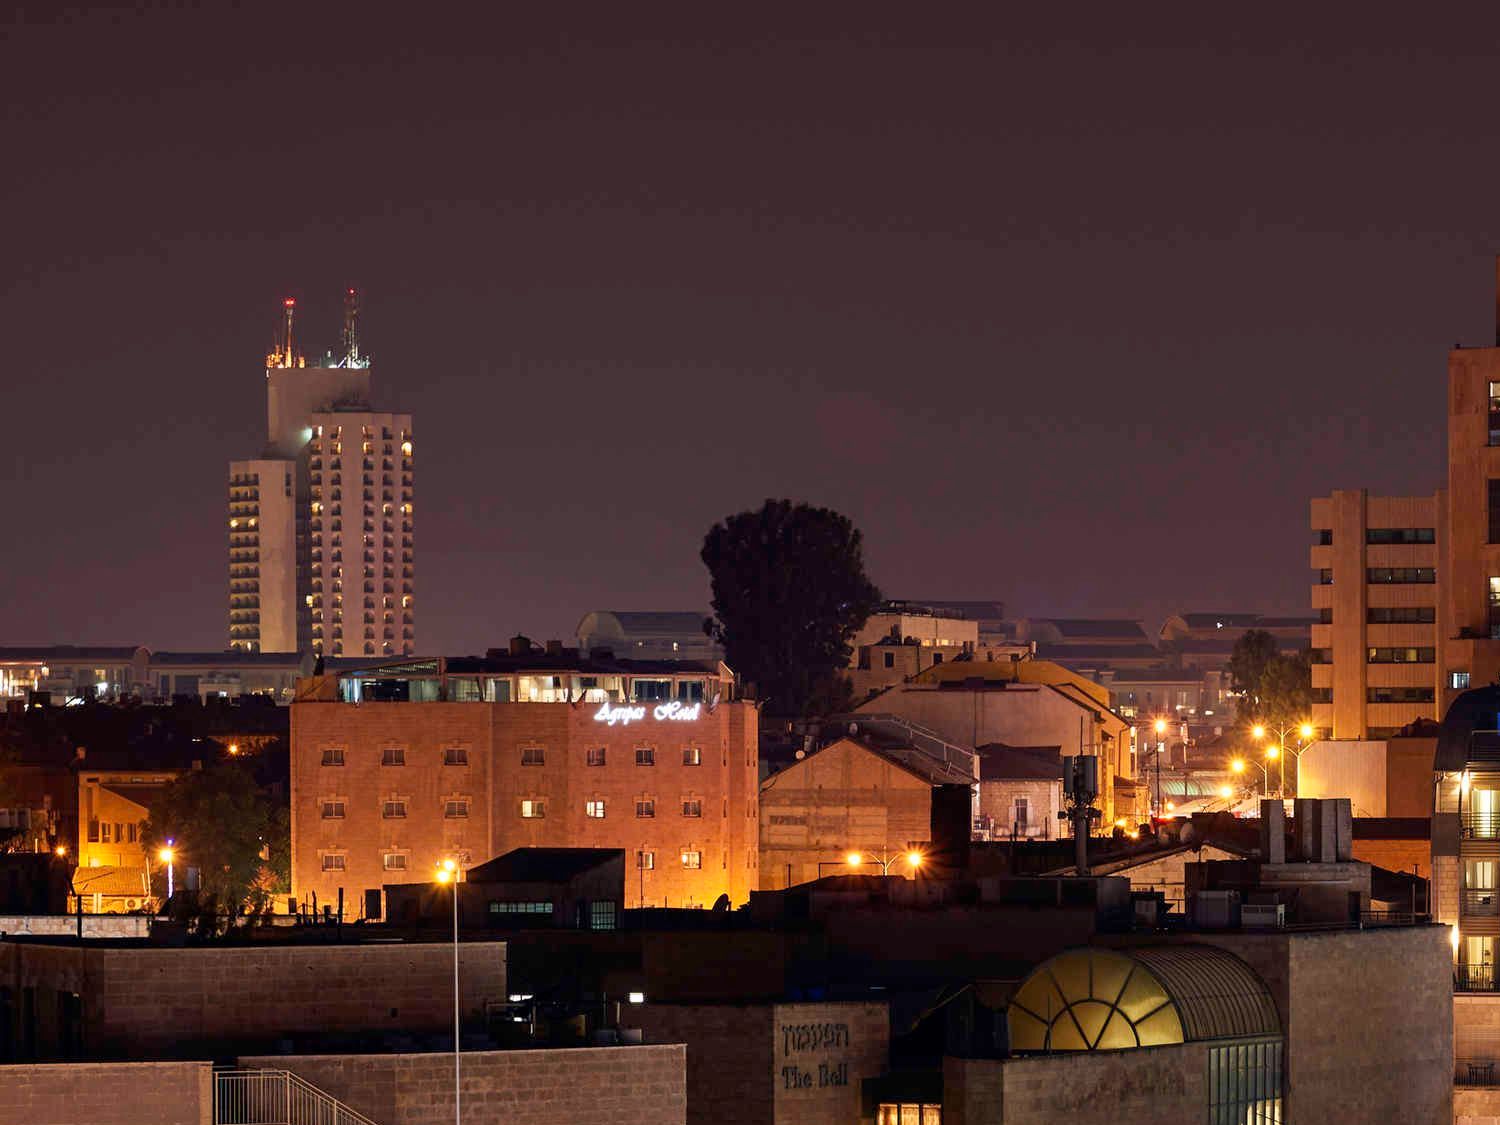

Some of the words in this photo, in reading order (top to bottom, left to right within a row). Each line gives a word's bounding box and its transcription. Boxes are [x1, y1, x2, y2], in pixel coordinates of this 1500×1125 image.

[654, 701, 701, 721] Hotel
[781, 1065, 813, 1088] The
[818, 1063, 849, 1088] Bell
